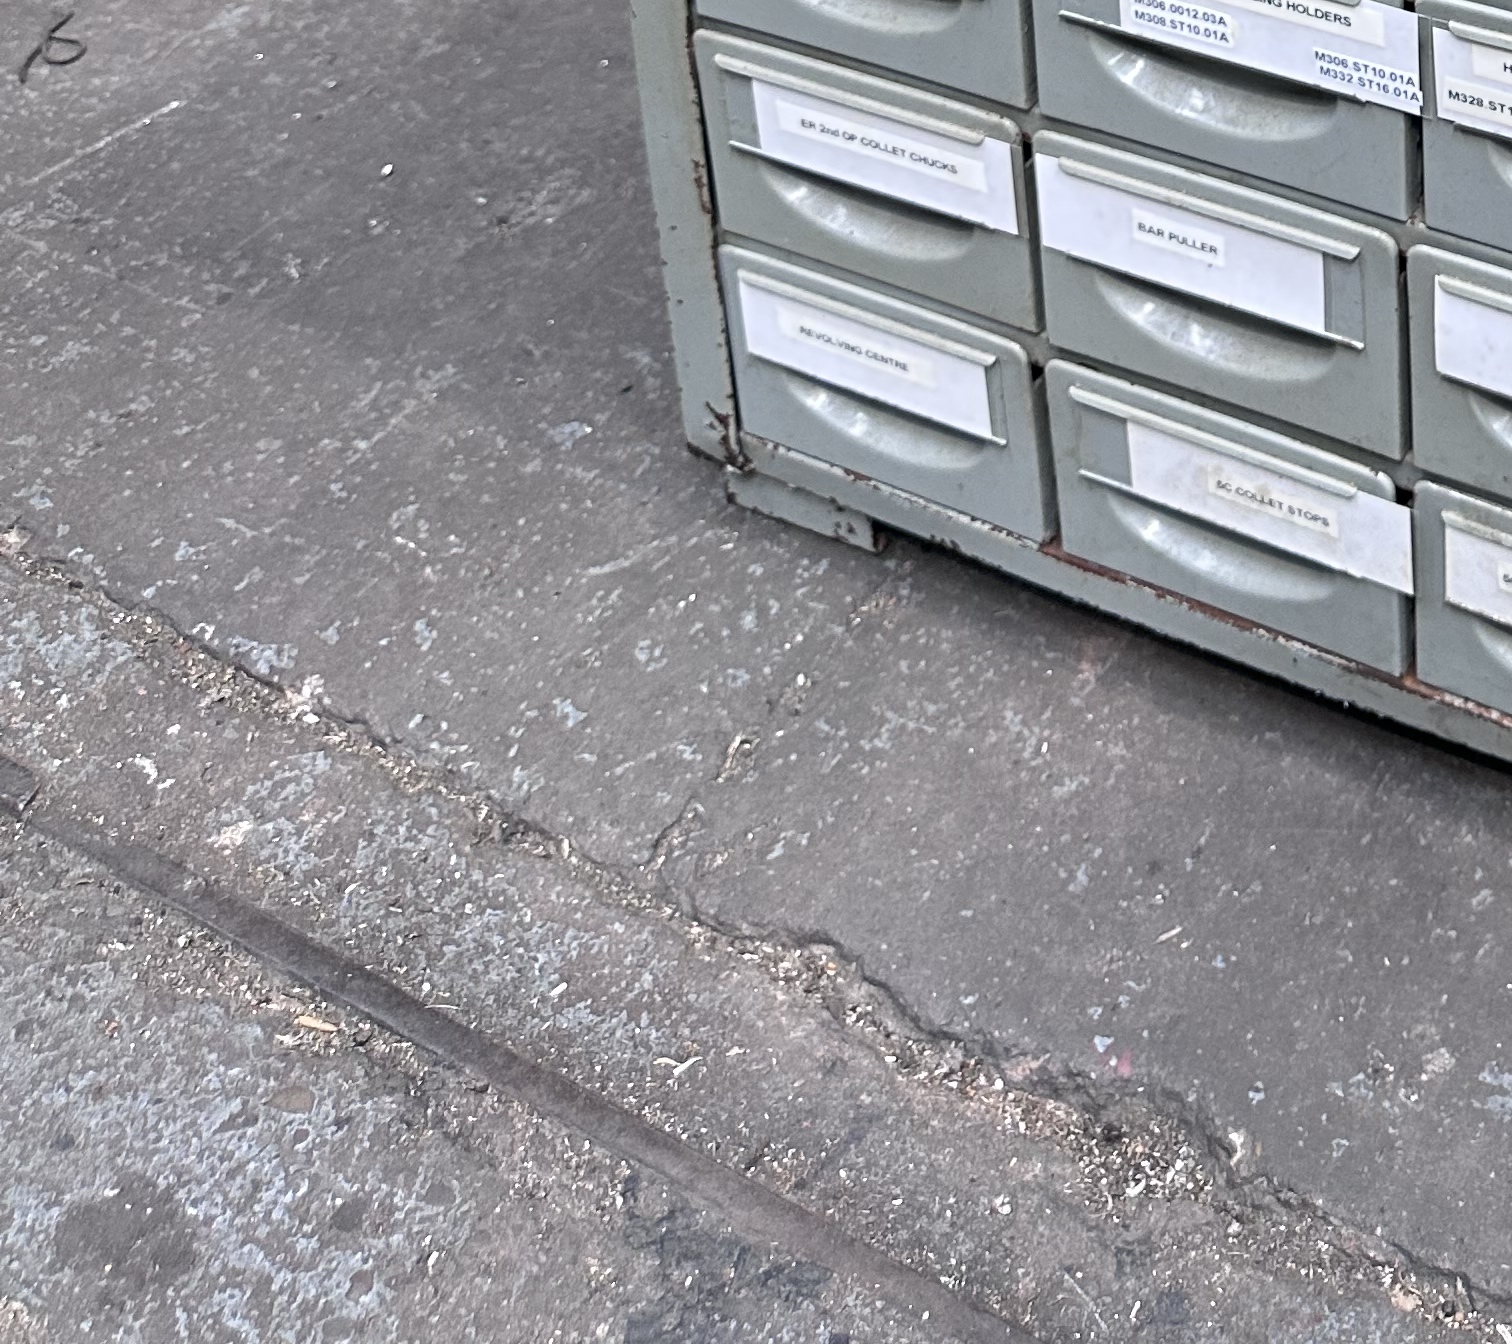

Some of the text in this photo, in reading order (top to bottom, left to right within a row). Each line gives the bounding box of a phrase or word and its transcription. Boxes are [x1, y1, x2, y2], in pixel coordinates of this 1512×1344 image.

[1286, 0, 1352, 28] HOLDERS
[800, 118, 958, 175] ER 2nd OP COLLET CHUCKS
[1137, 221, 1218, 256] BAR PULLER
[864, 348, 910, 372] CENTRE
[1234, 486, 1284, 511] COLLET
[1287, 504, 1330, 528] STOPS
